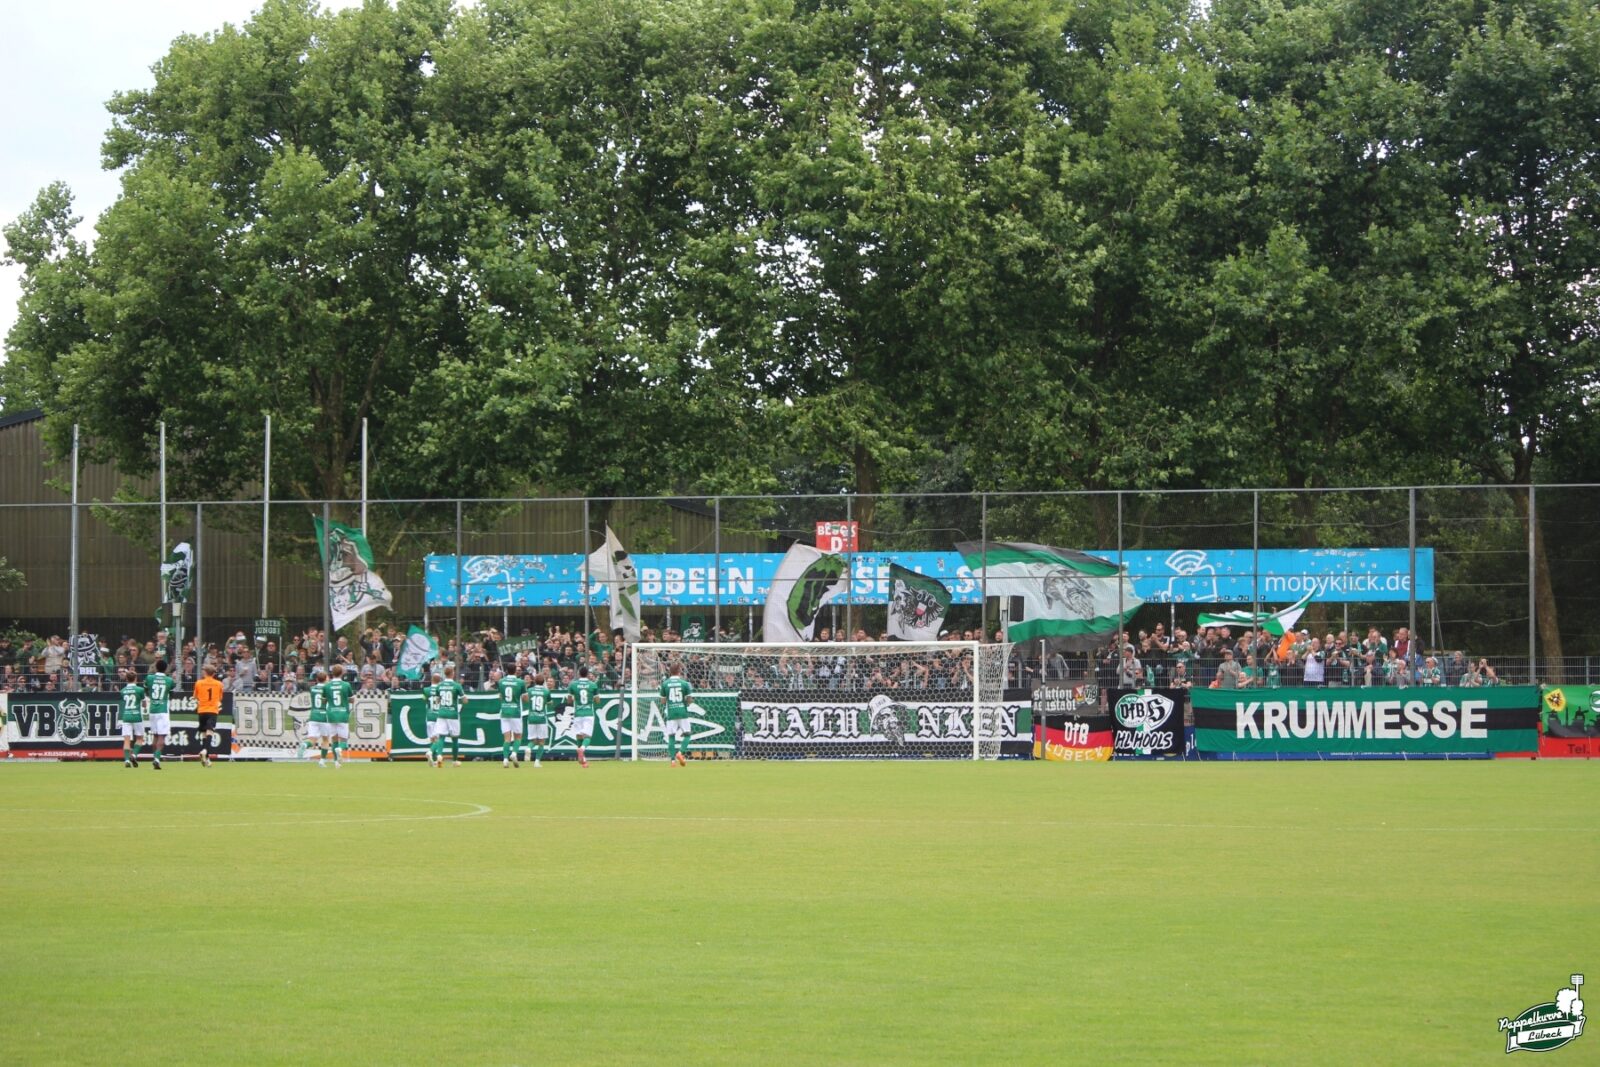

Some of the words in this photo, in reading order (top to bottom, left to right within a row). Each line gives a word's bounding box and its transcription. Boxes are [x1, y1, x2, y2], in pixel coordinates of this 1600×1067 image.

[151, 684, 166, 700] 37
[207, 688, 213, 702] 1
[332, 691, 342, 706] 5
[440, 691, 453, 706] 39
[504, 687, 513, 702] 9
[580, 689, 588, 704] 8
[668, 687, 682, 702] 45
[123, 695, 136, 709] 22
[314, 693, 322, 708] 6
[531, 696, 544, 711] 19
[1120, 703, 1145, 720] VfB
[1235, 700, 1488, 739] KRUMMESSE
[1064, 721, 1089, 746] VfB
[1133, 731, 1173, 750] HOOLS
